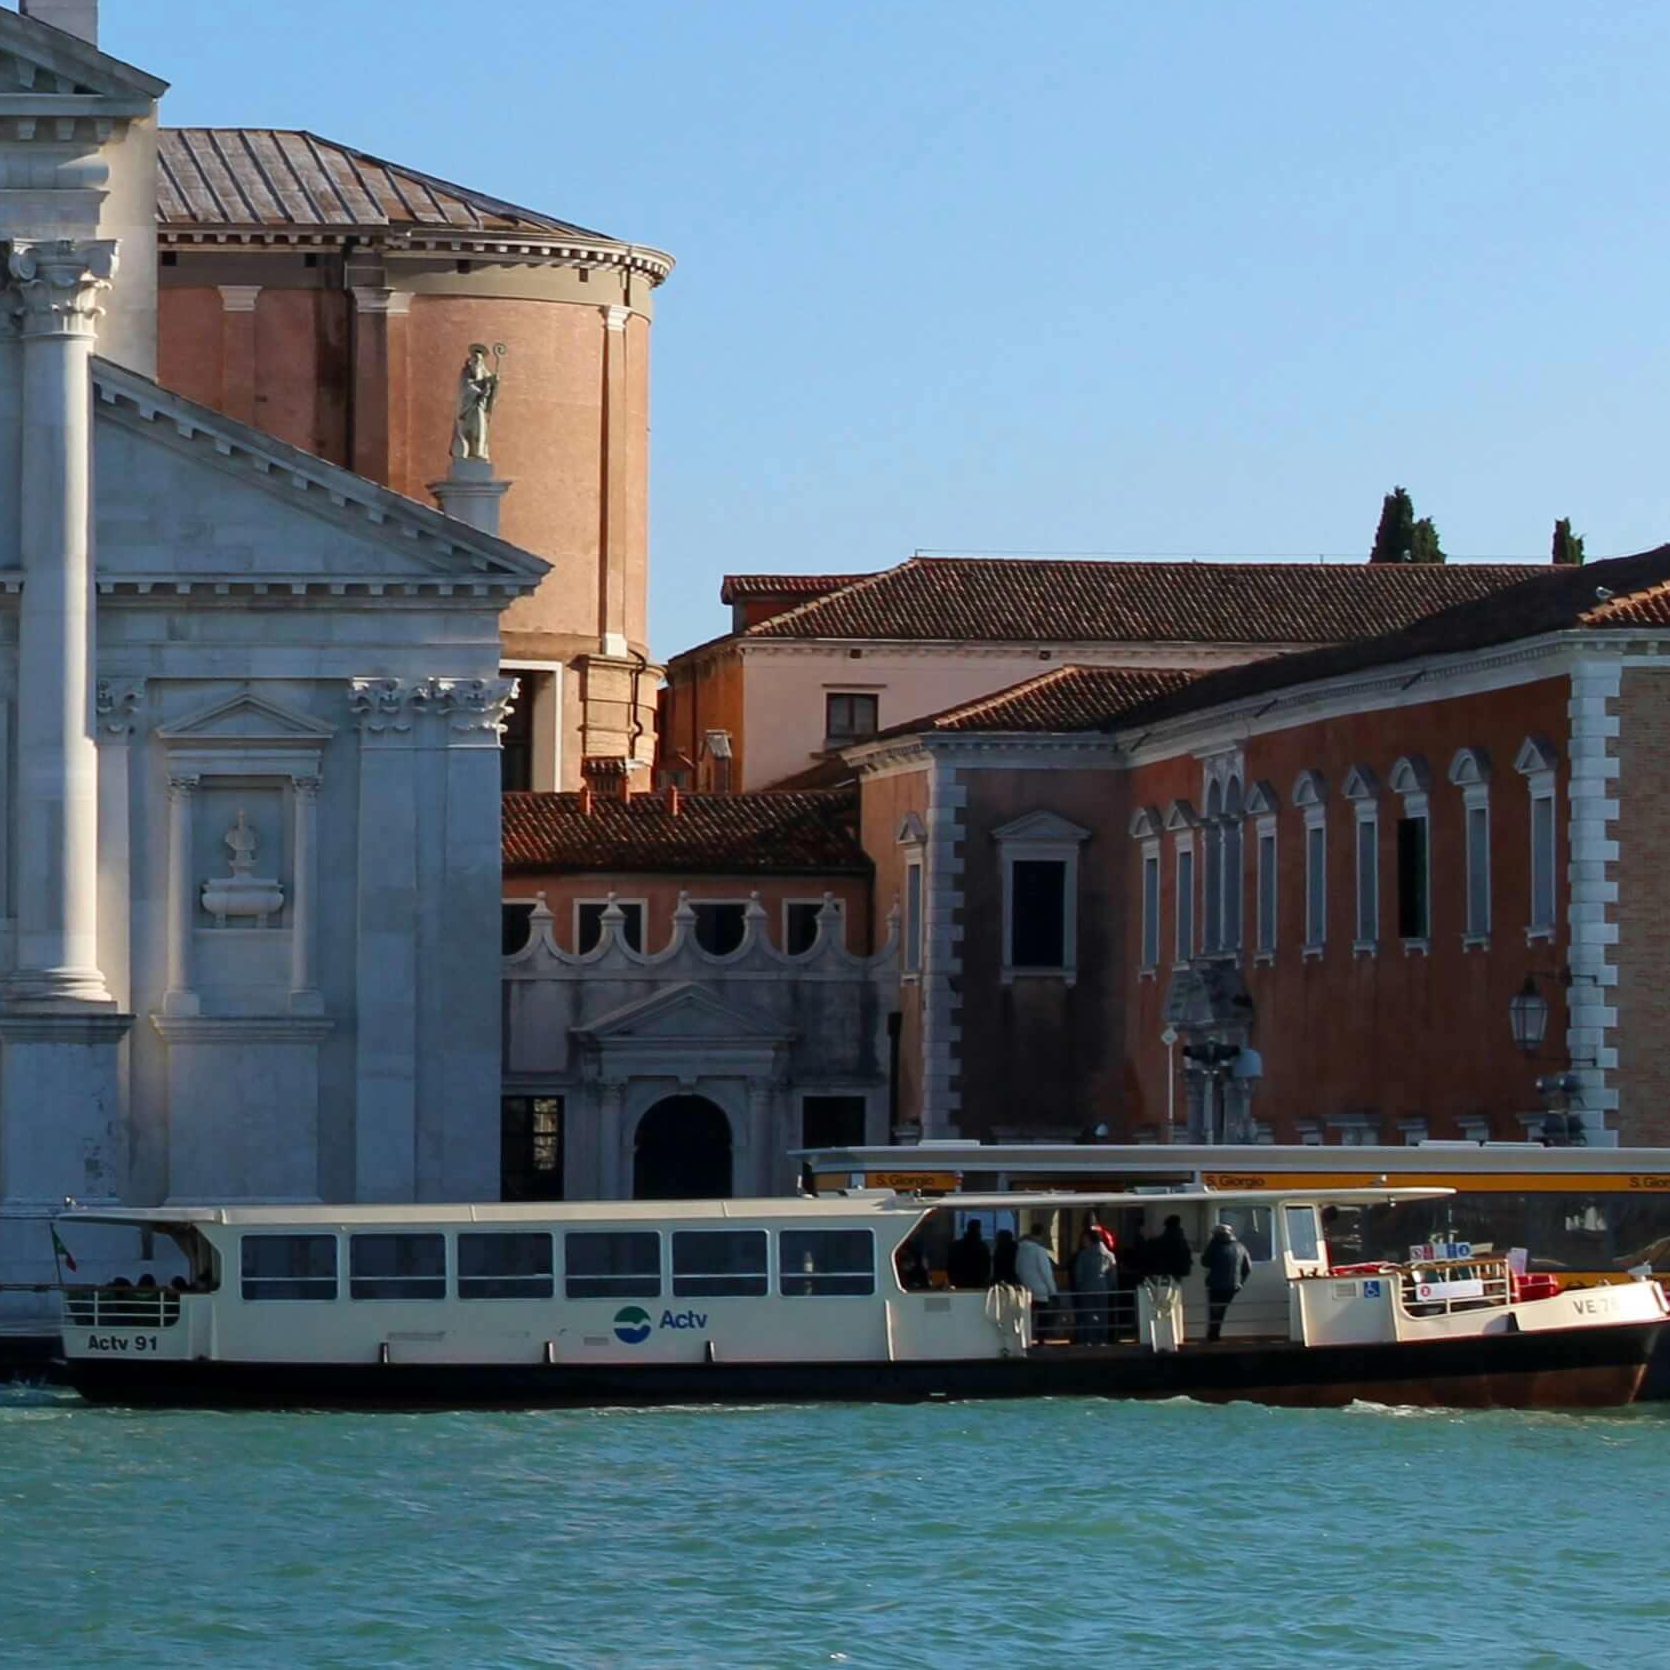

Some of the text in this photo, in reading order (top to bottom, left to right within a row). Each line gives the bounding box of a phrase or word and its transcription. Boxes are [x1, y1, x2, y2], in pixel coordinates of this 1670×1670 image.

[890, 1174, 934, 1188] Giorgio
[1220, 1175, 1265, 1189] Giorgio
[1572, 1300, 1596, 1315] VE
[659, 1310, 708, 1329] Actv
[88, 1335, 157, 1351] Actv 91
